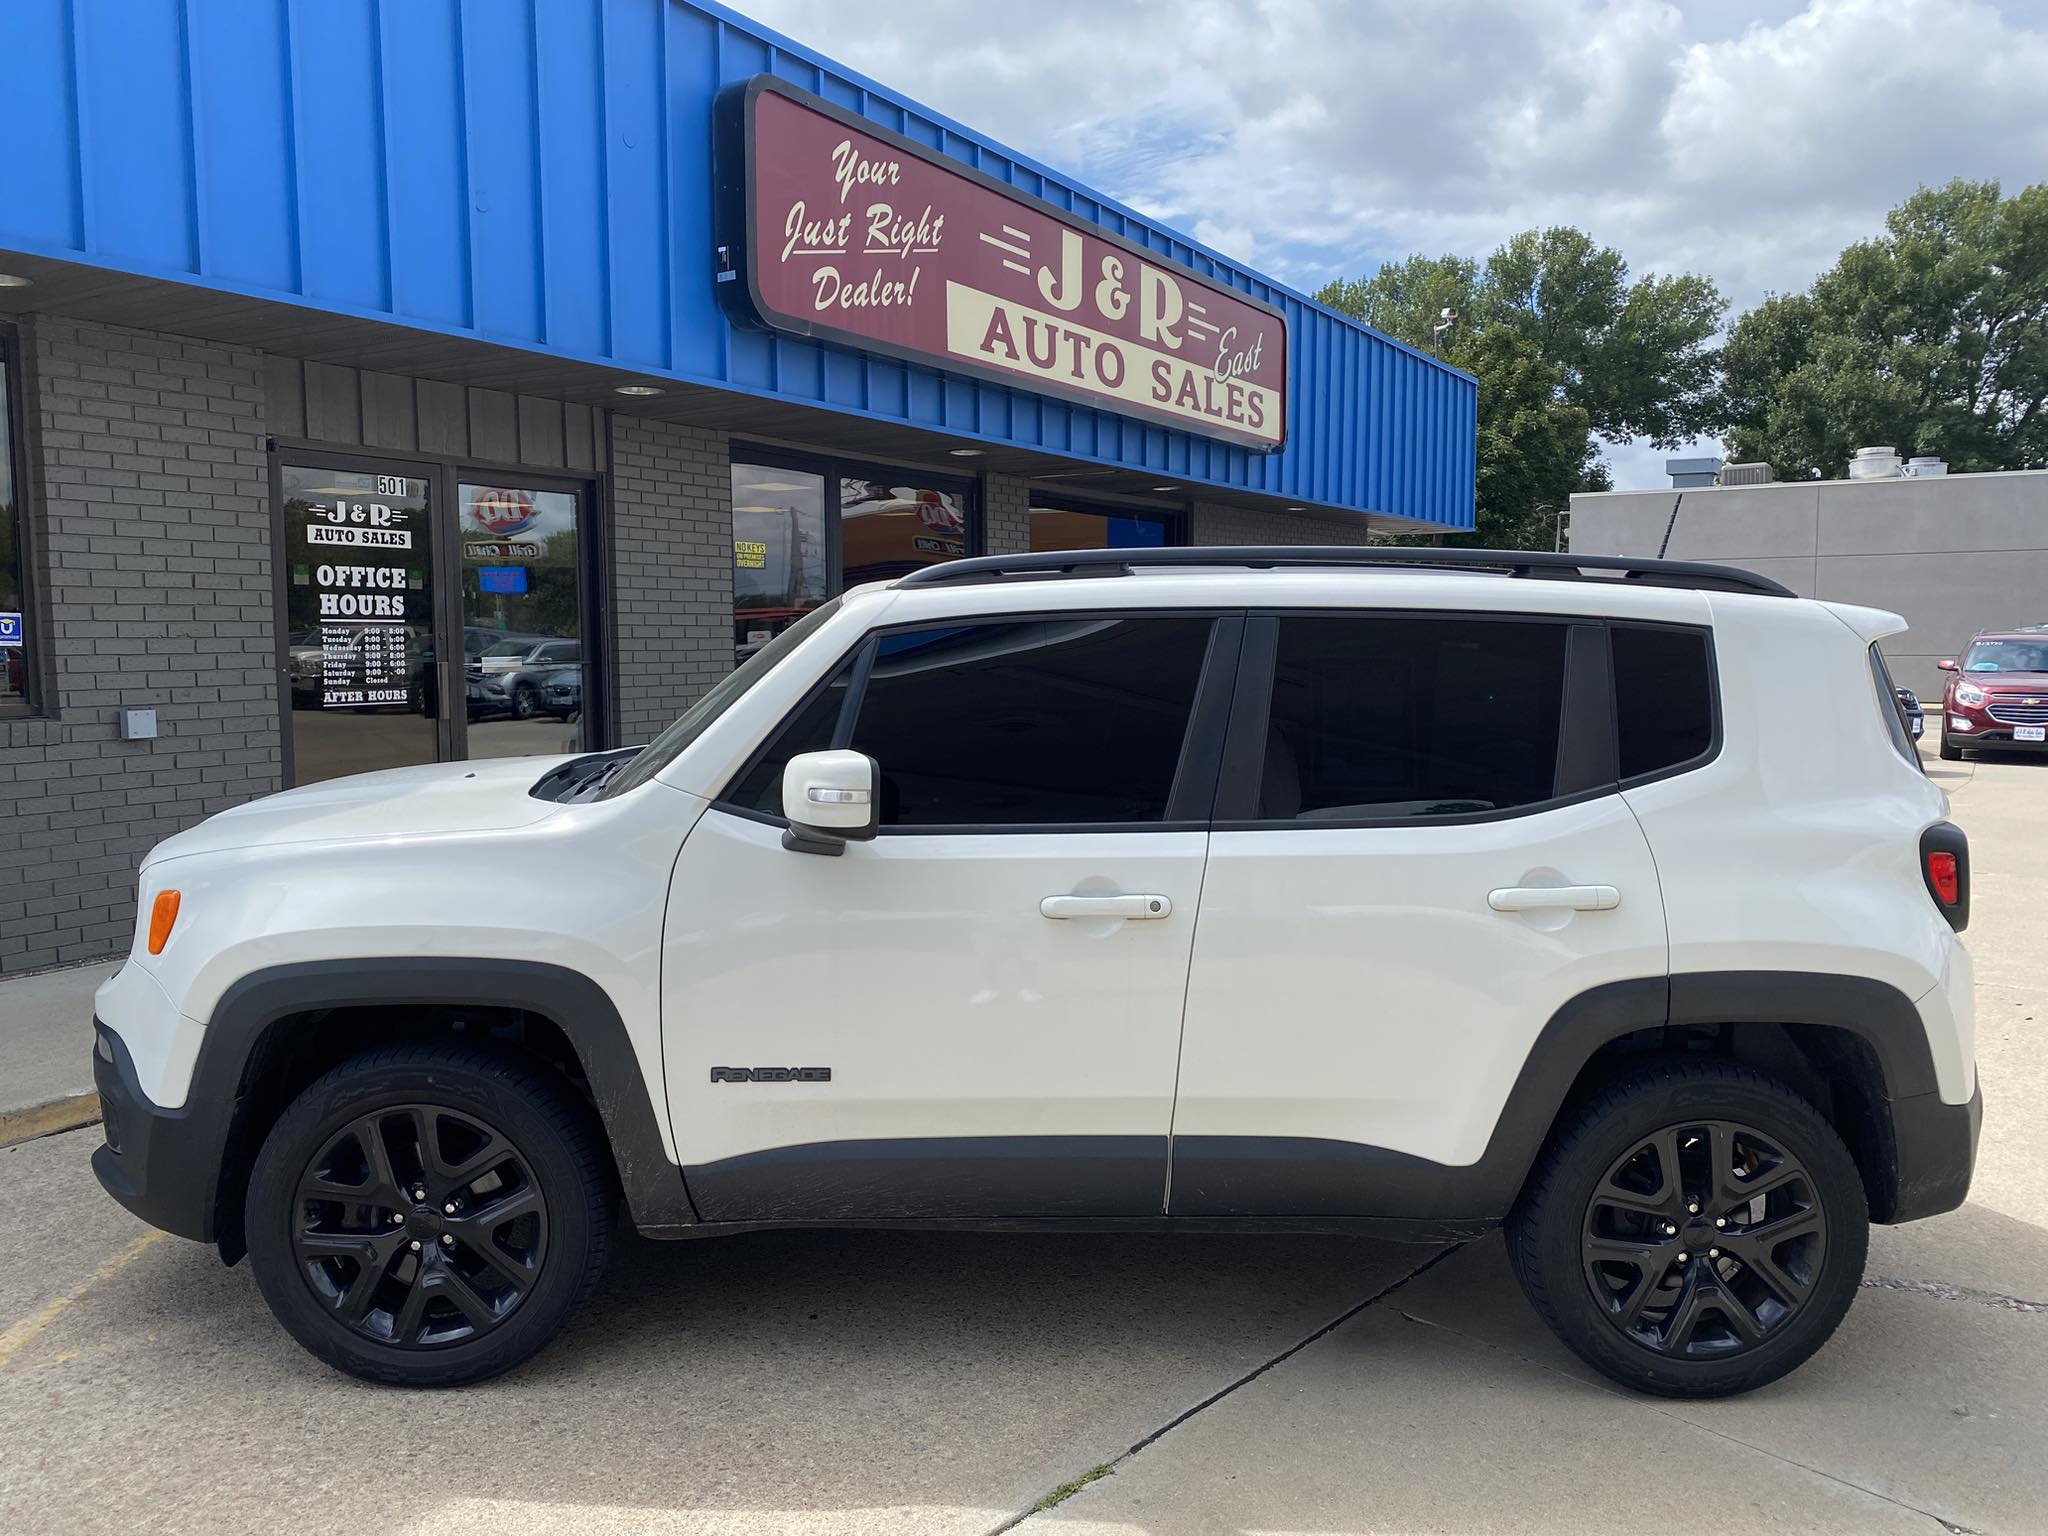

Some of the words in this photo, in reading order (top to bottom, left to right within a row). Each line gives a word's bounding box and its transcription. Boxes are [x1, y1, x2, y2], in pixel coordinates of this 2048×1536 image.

[832, 139, 900, 204] Your
[781, 200, 852, 263] Just
[865, 203, 944, 259] Right
[812, 266, 920, 311] Dealer!
[1037, 229, 1083, 311] J
[1095, 255, 1131, 320] &
[1140, 263, 1183, 349] R
[980, 306, 1125, 388] AUTO
[1151, 359, 1264, 429] SALES
[1213, 326, 1263, 384] East
[379, 476, 404, 495] 501
[327, 501, 346, 523] J
[350, 504, 366, 522] &
[370, 503, 391, 527] R
[314, 528, 355, 542] AUTO
[361, 531, 406, 546] SALES
[747, 543, 764, 553] KEYS
[316, 564, 406, 589] OFFICE
[319, 593, 405, 616] HOURS
[324, 691, 363, 702] AFTER
[368, 690, 407, 701] HOURS
[711, 1067, 831, 1083] RENEGADE
